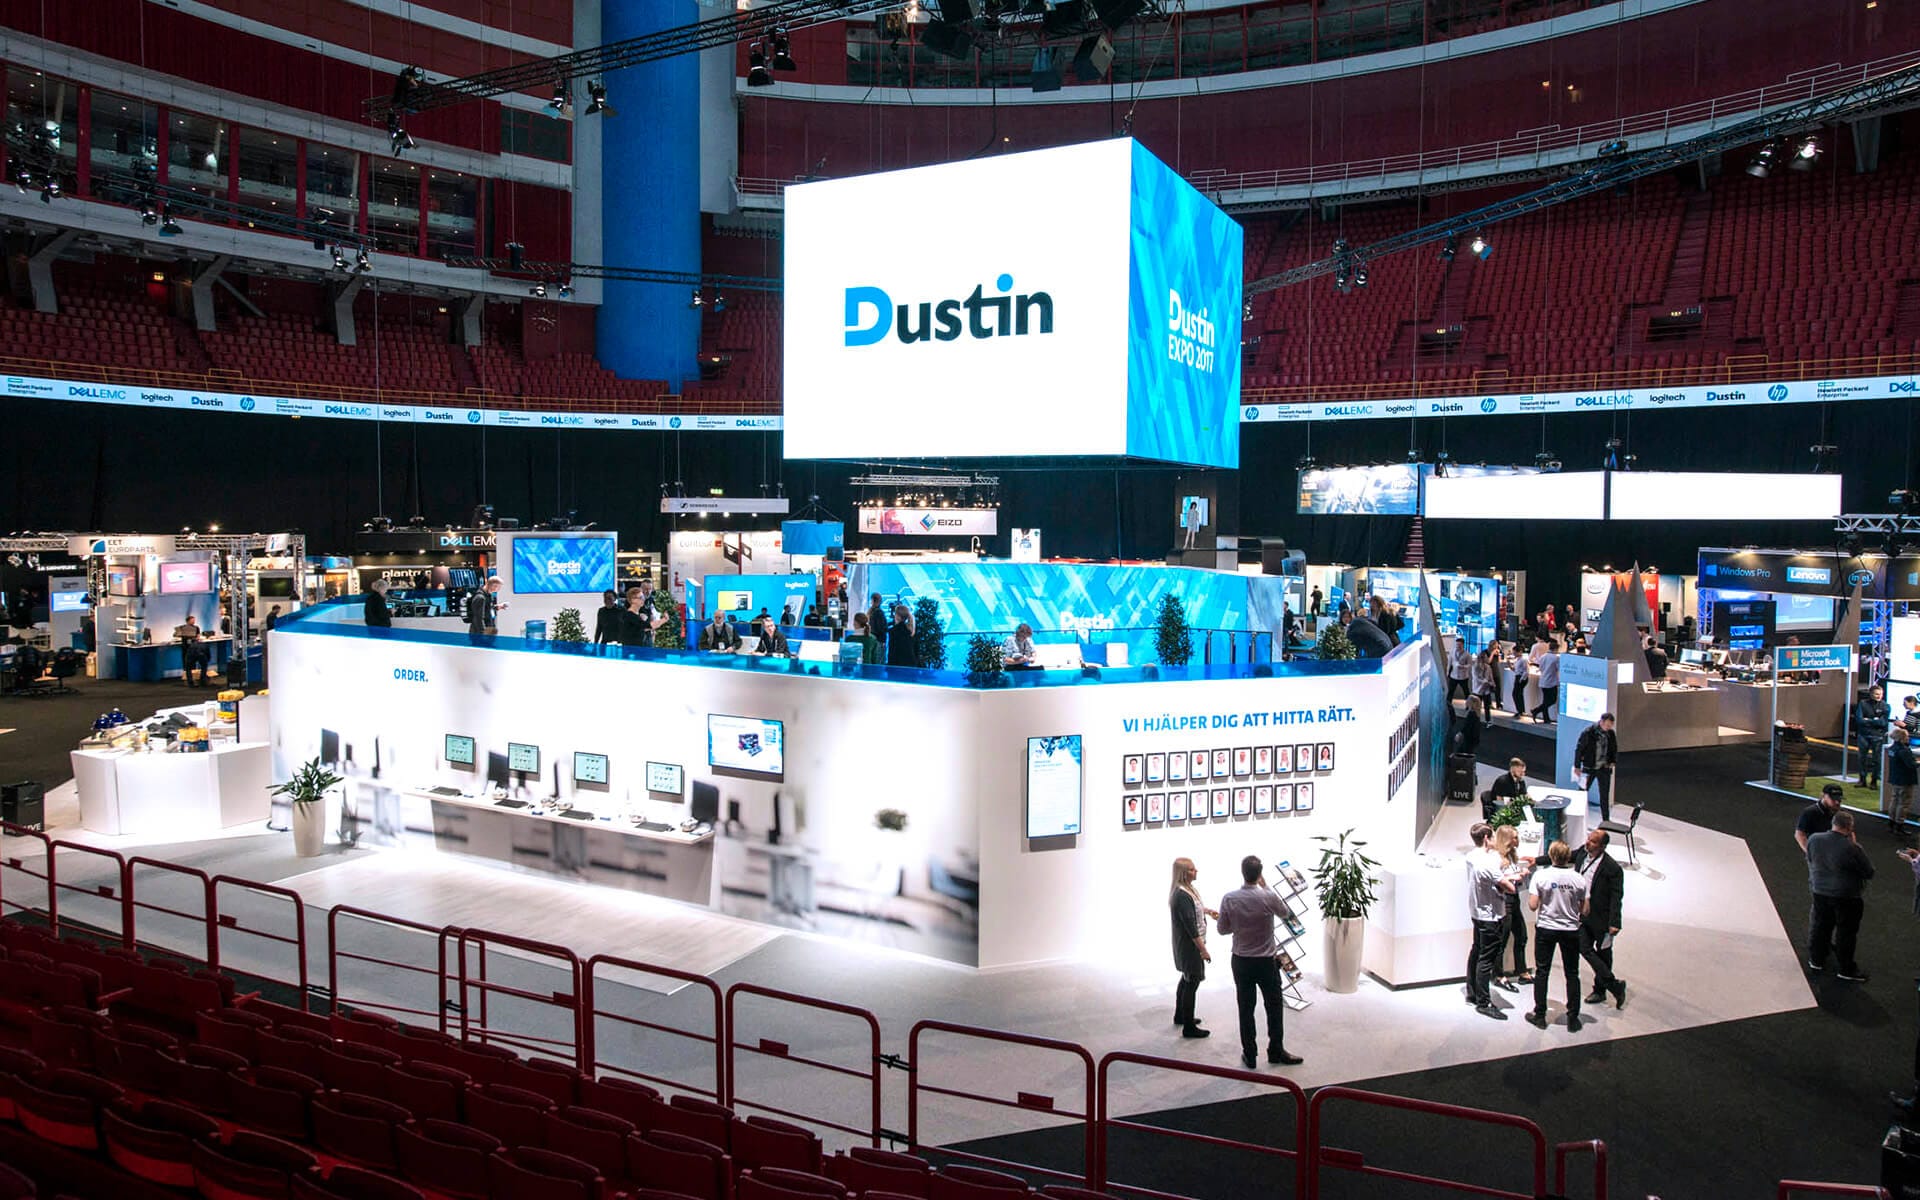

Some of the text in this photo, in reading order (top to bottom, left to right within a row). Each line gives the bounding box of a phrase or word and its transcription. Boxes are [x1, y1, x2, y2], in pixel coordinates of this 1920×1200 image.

[845, 273, 1053, 347] Dustin
[1169, 288, 1215, 348] Dustin
[1168, 333, 1214, 373] EXPO 2017
[141, 392, 174, 402] logitech
[1650, 393, 1685, 404] logitech
[1706, 390, 1745, 401] Dustin
[191, 396, 223, 407] Dustin
[1385, 404, 1414, 414] logitech
[1432, 403, 1463, 412] Dustin
[383, 409, 411, 418] logitech
[425, 411, 453, 420] Dustin
[594, 417, 618, 425] logitech
[632, 418, 657, 426] Dustin
[548, 560, 581, 569] Dustin
[1719, 566, 1771, 578] Windows Pro
[1790, 569, 1827, 581] Lenovo
[785, 581, 809, 590] logitech
[1801, 649, 1830, 658] Microsoft
[1801, 657, 1841, 666] Surface Book
[394, 668, 428, 682] ORDER.
[1123, 705, 1356, 733] VI HJÄLPER DIG ATT HITTA RÄTT.
[1454, 791, 1470, 799] LIVE
